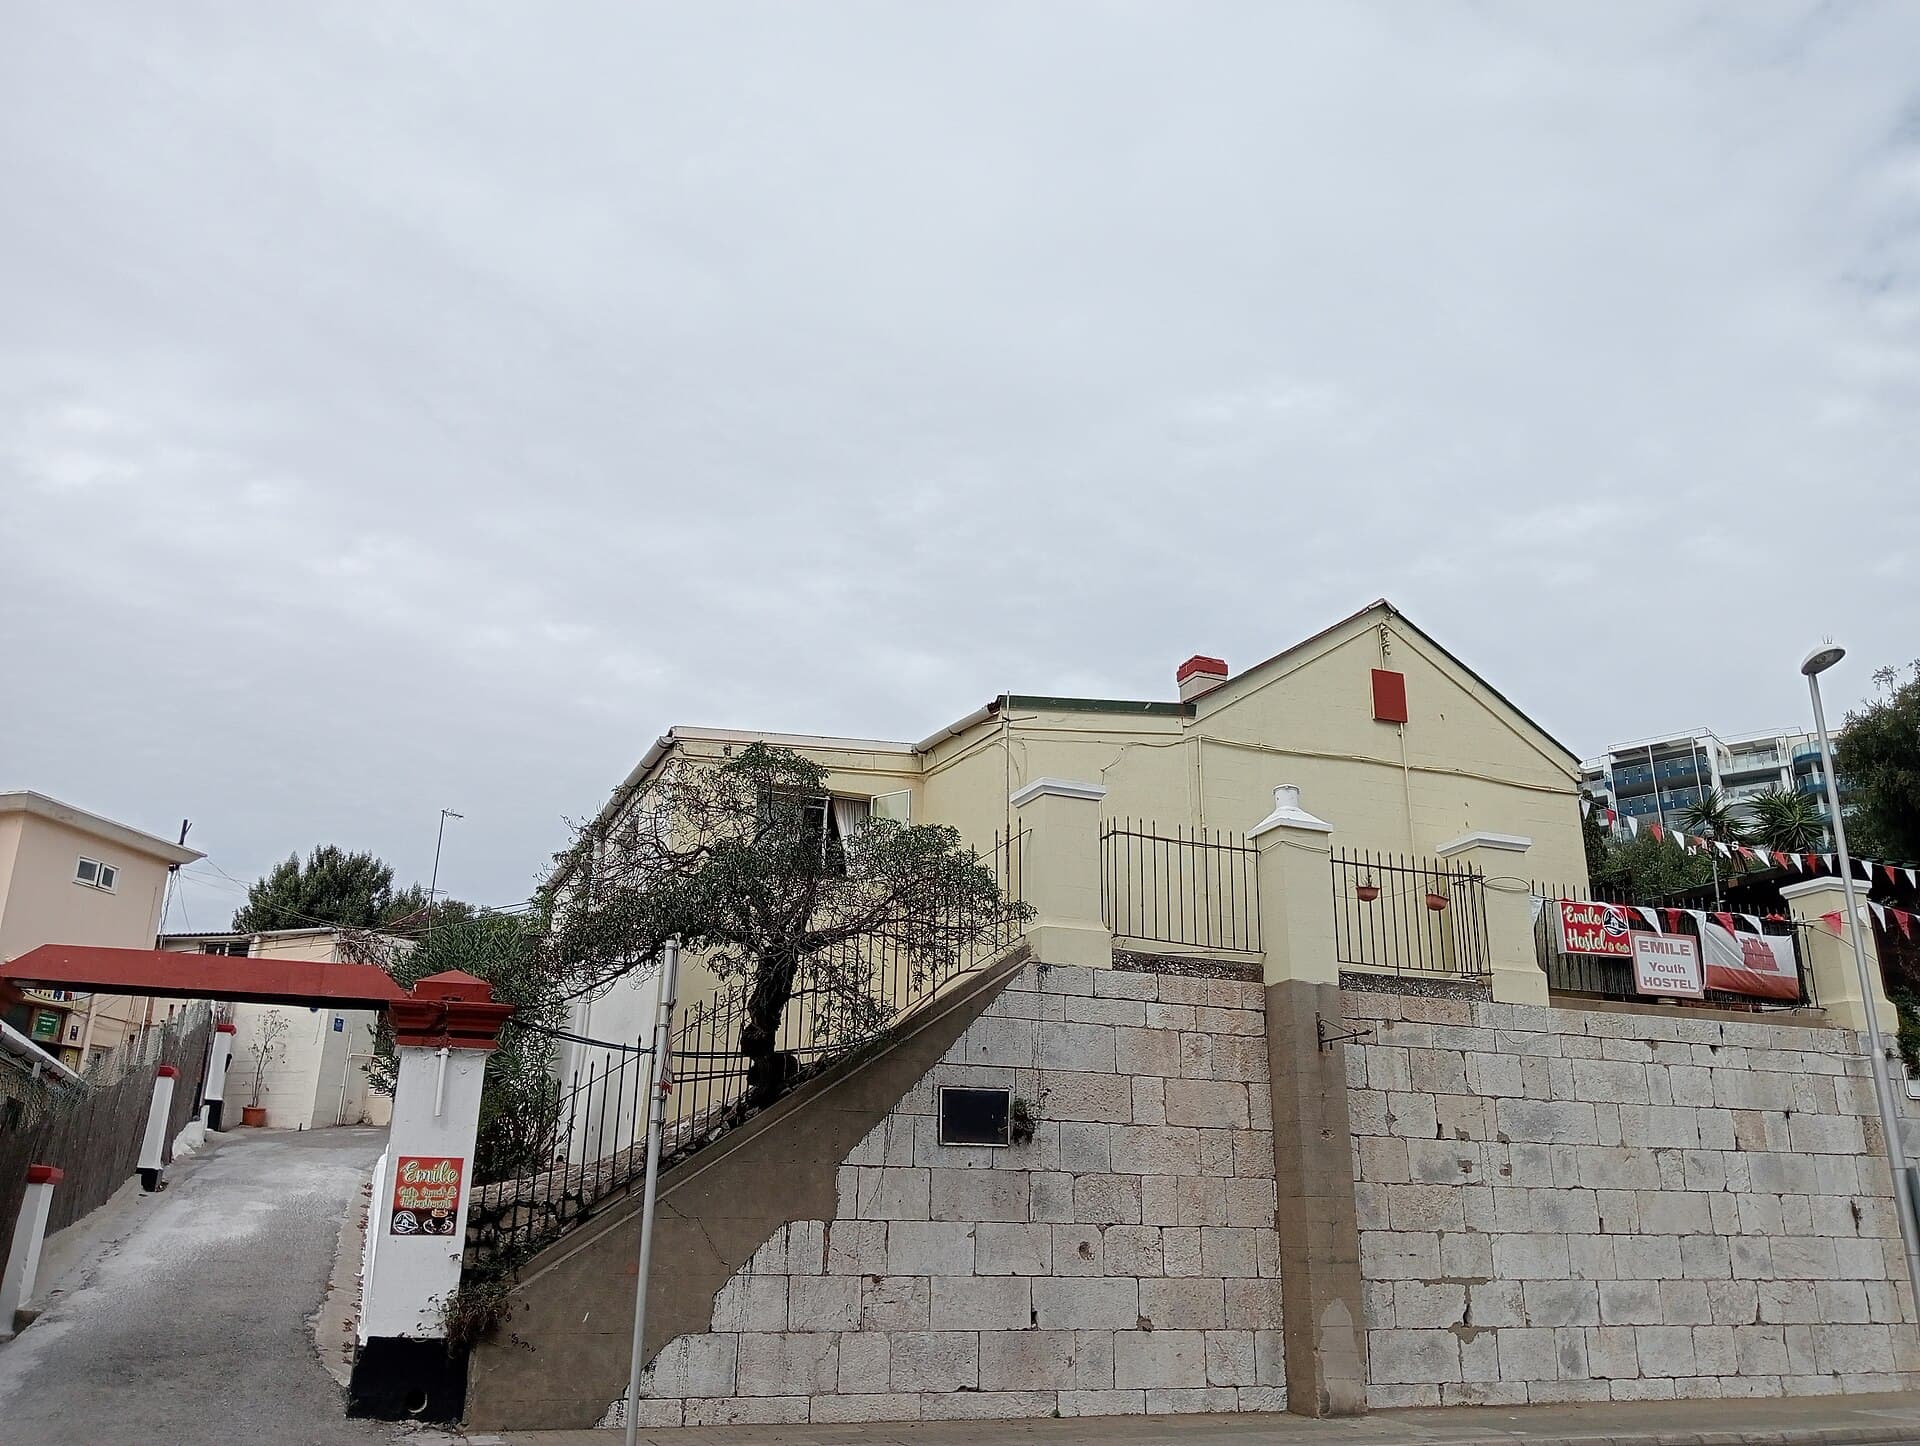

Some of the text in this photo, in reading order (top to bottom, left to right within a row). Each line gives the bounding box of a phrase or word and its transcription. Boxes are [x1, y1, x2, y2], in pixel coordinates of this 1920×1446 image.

[1563, 905, 1602, 925] Emile
[1567, 928, 1607, 951] Hostel
[1638, 940, 1691, 956] EMILE
[1650, 961, 1686, 974] Youth
[1643, 976, 1696, 990] HOSTEL
[400, 1160, 458, 1184] Emile
